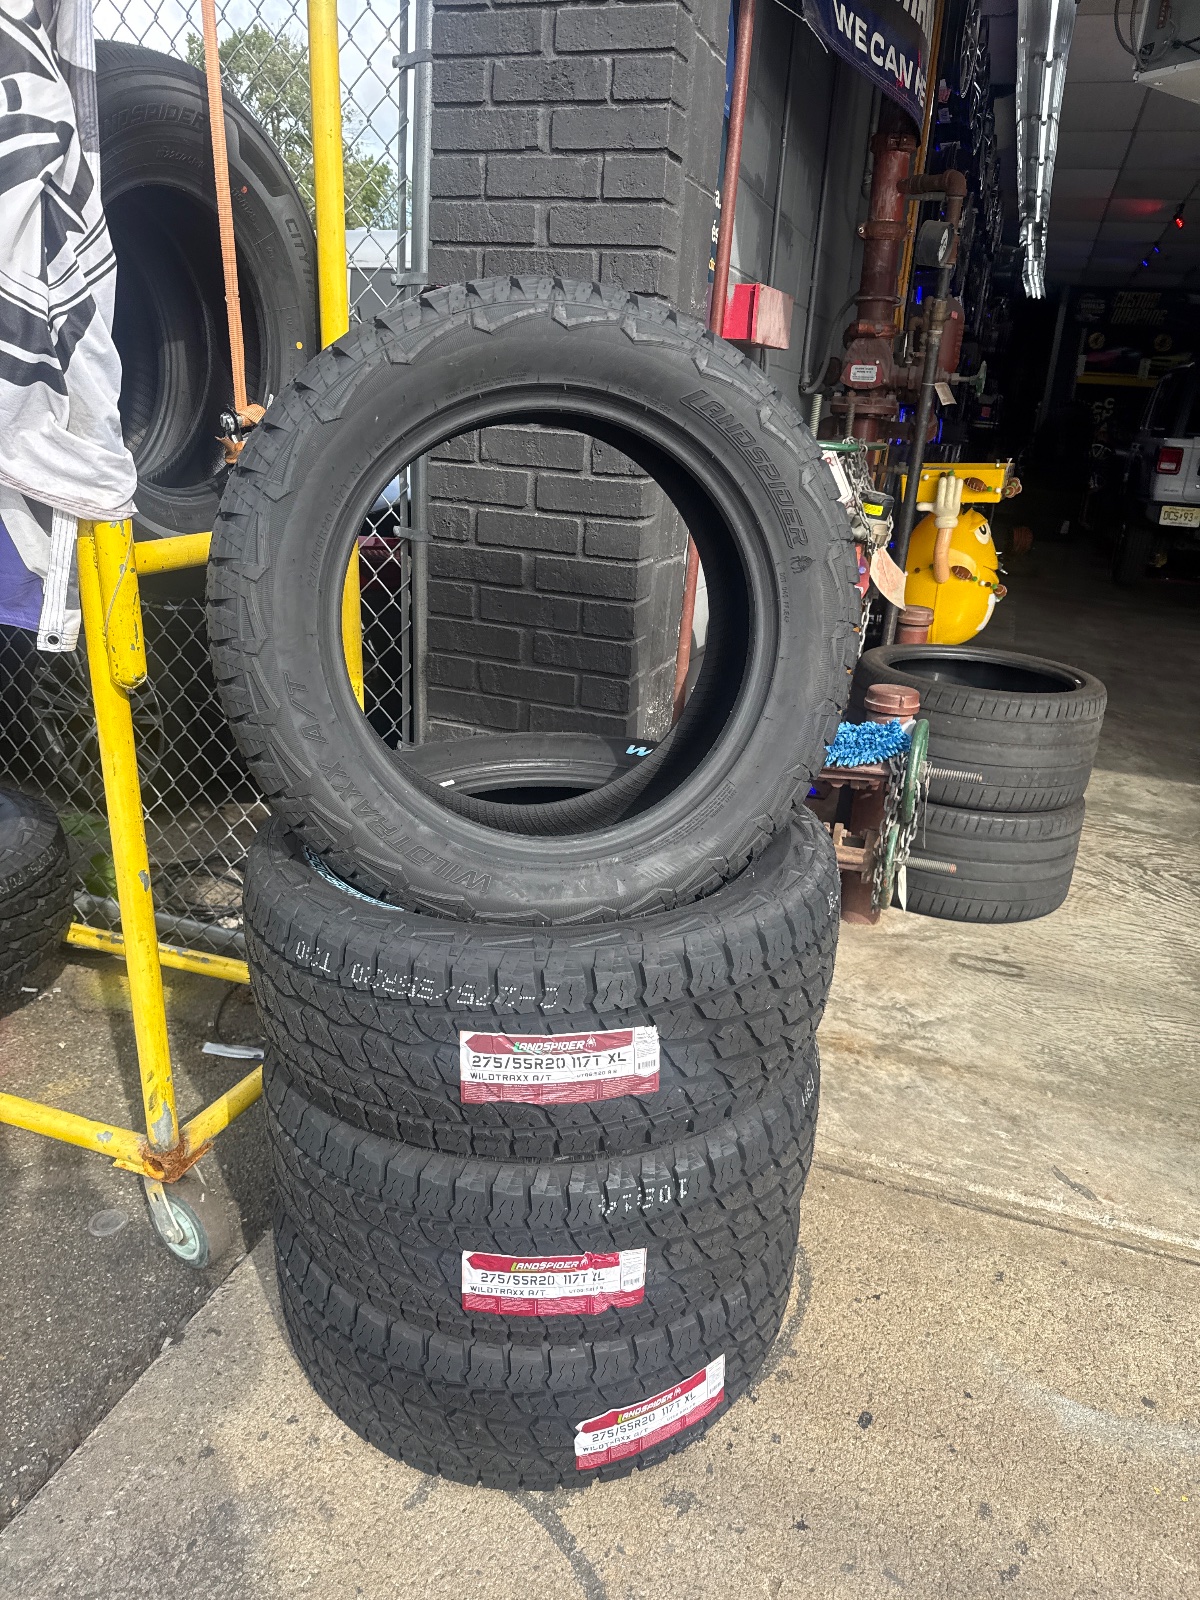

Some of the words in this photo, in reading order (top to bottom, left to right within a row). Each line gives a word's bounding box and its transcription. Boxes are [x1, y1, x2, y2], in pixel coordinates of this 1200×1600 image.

[833, 0, 868, 54] WE
[870, 31, 914, 90] CAN
[680, 389, 809, 549] LANDSPIDER
[282, 671, 329, 744] A/T
[318, 761, 492, 894] WILDTRAXX
[513, 1040, 585, 1053] LANDSPIDER
[472, 1055, 566, 1070] 275/55R20
[571, 1055, 602, 1069] 117T
[608, 1052, 627, 1064] XL
[470, 1072, 529, 1082] WILDTRAXX
[532, 1074, 552, 1082] A/T
[480, 1272, 555, 1286] 275/55R20
[563, 1272, 588, 1285] 117T
[511, 1260, 579, 1272] LANDSPIDER
[469, 1286, 525, 1297] WILDTRAXX
[528, 1289, 547, 1297] A/T
[592, 1413, 656, 1442] 275/55R20
[661, 1400, 682, 1417] 117T
[684, 1394, 697, 1405] XL
[617, 1391, 674, 1425] LANDSPIDER
